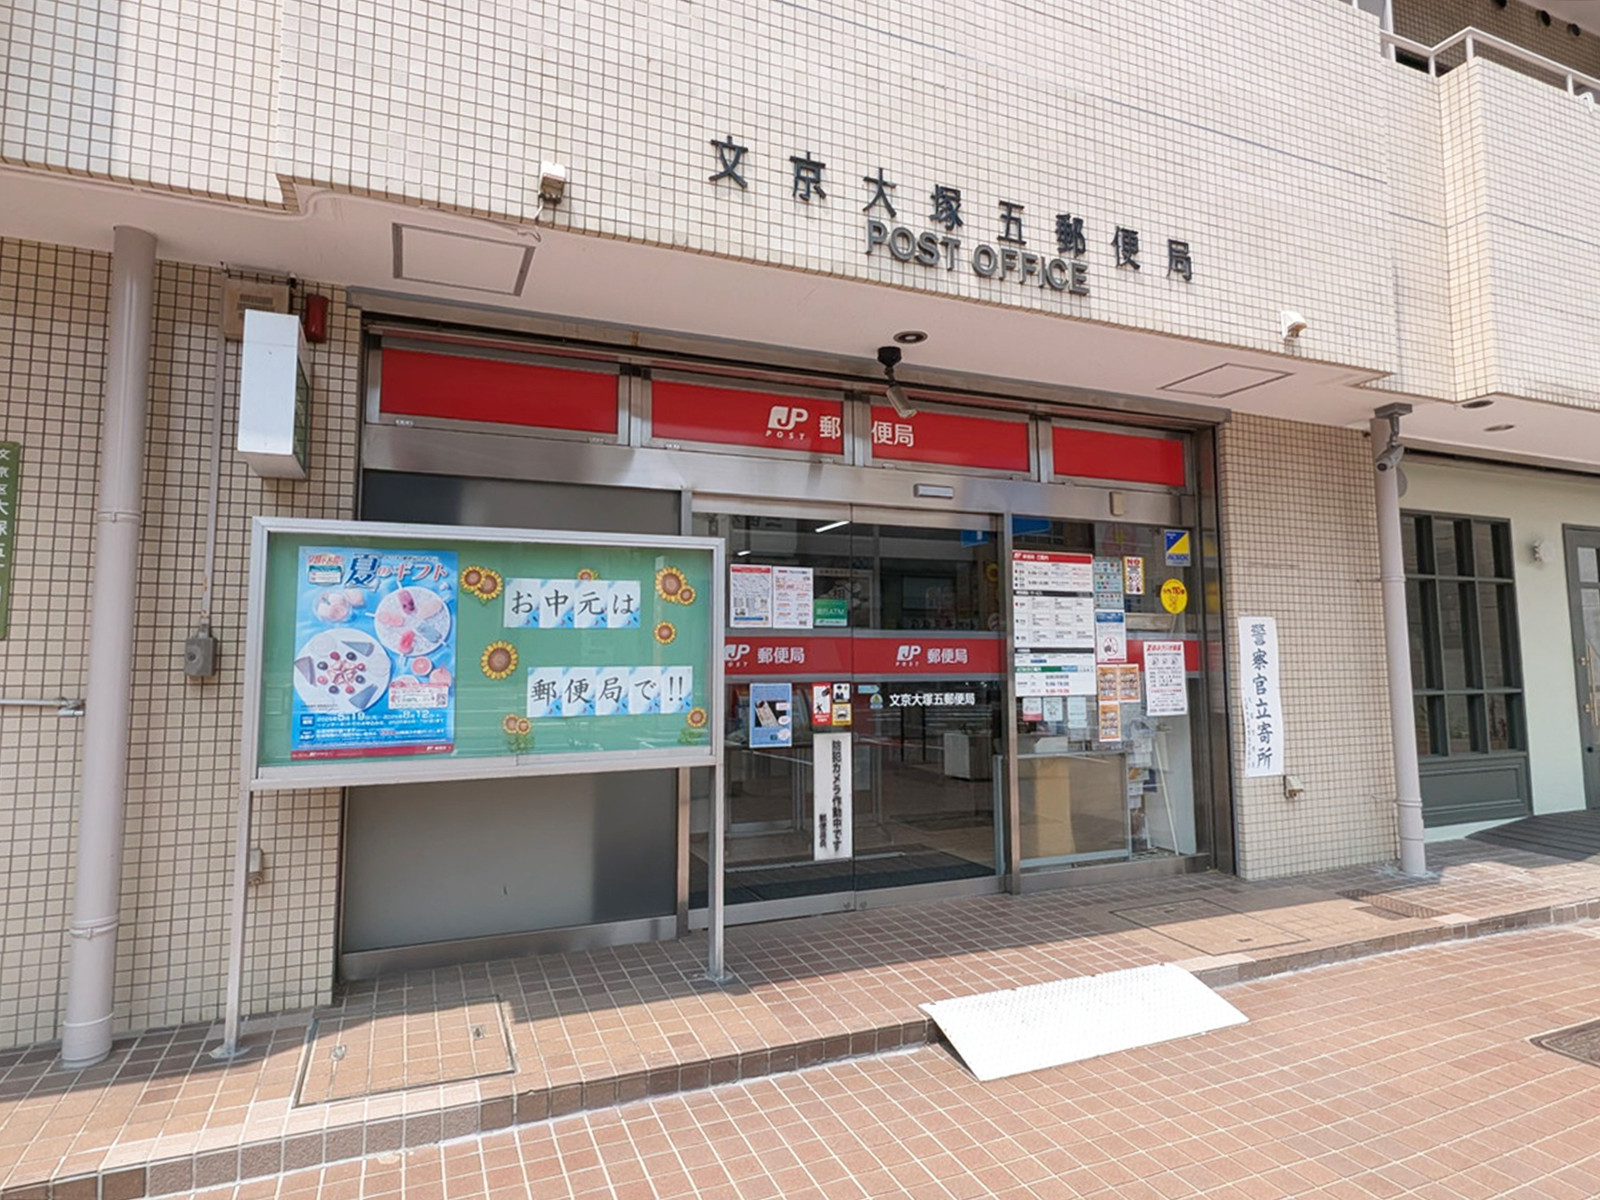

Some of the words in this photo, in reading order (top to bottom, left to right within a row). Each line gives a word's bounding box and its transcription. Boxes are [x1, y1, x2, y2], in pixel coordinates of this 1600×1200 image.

[709, 135, 1193, 282] 文京大塚五郵便局
[865, 218, 961, 271] POST
[971, 243, 1090, 296] OFFICE
[768, 405, 809, 430] JP
[819, 415, 914, 447] 郵便局
[765, 430, 806, 440] POST
[345, 553, 449, 588] 夏のギフト
[1126, 558, 1140, 566] NO
[511, 588, 634, 618] お中元は
[757, 646, 805, 664] 郵便局
[927, 647, 968, 664] 郵便局
[889, 692, 976, 707] 文京大塚五郵便局
[1250, 623, 1273, 770] 警察官立寄所
[831, 739, 843, 853] 防犯カメラ作動中です
